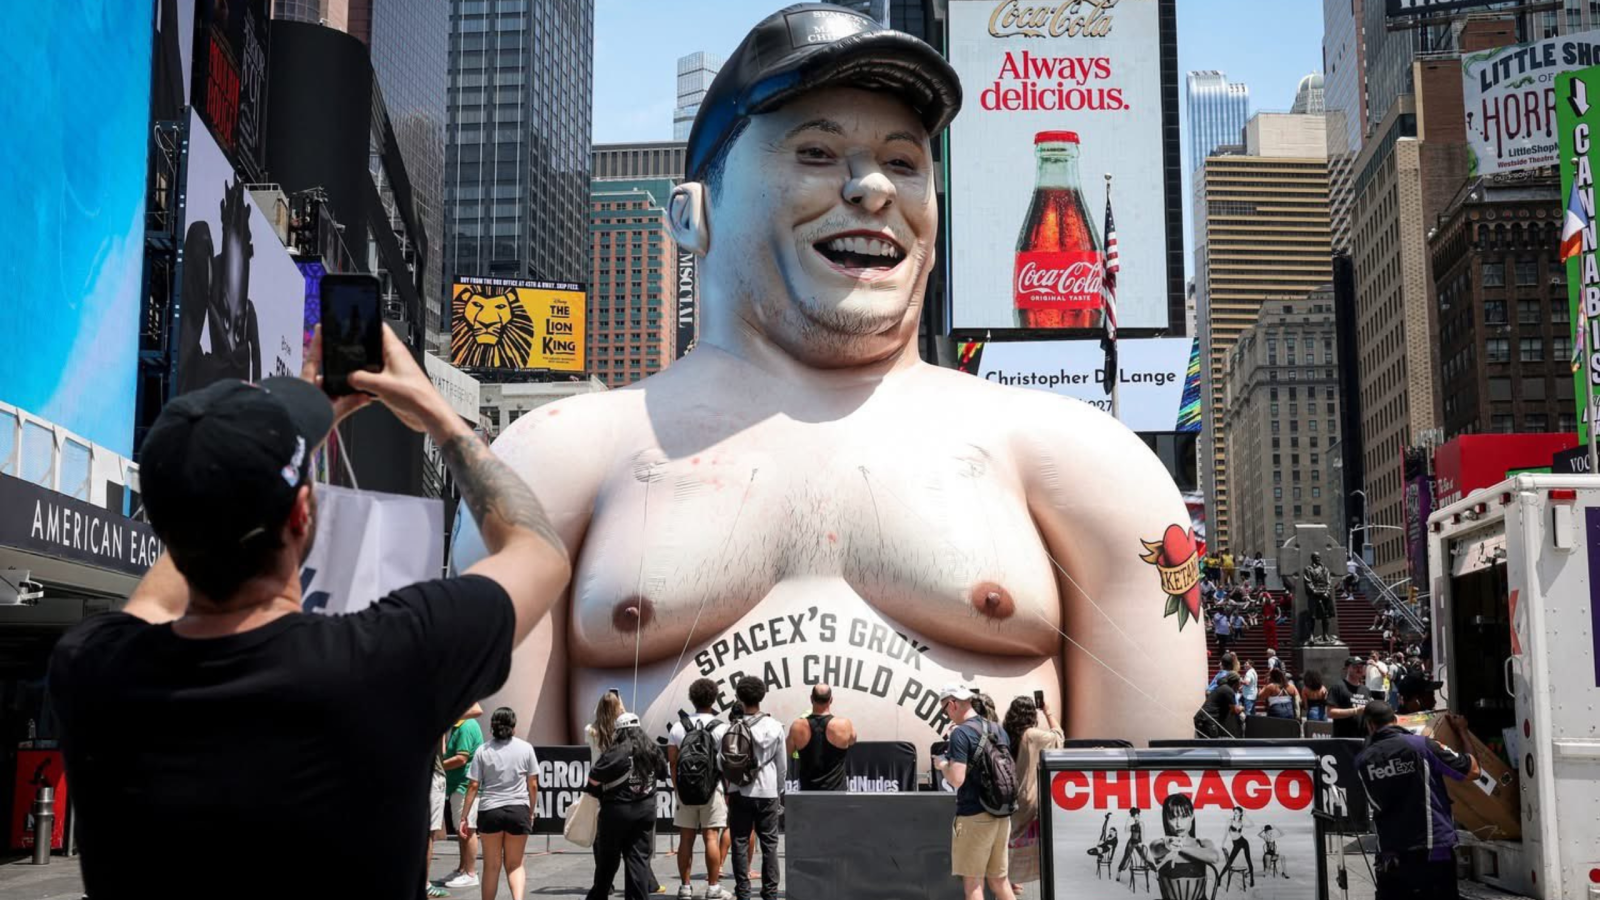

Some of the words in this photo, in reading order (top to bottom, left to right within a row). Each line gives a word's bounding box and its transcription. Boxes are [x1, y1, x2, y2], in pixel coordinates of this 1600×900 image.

[988, 0, 1118, 38] Coca-Cola
[998, 50, 1111, 86] Always
[1480, 43, 1557, 93] LITTLE
[1562, 41, 1600, 66] SHO
[1538, 73, 1554, 83] OF
[980, 81, 1130, 111] delicious.
[1482, 88, 1557, 150] HORR
[1497, 159, 1527, 168] Westside
[1529, 155, 1554, 164] Theatre
[1508, 142, 1560, 157] LittleShopN
[1574, 122, 1600, 386] CANNABIS
[1018, 262, 1103, 294] Coca-Cola
[549, 305, 570, 315] THE
[546, 318, 573, 335] LION
[542, 336, 576, 355] KING
[985, 369, 1089, 388] Christopher
[1119, 369, 1177, 386] Lange
[1570, 454, 1591, 472] VOC
[31, 499, 123, 560] AMERICAN
[130, 530, 162, 568] EAGL
[694, 606, 837, 676] SPACEX'S
[849, 617, 931, 671] GROK
[763, 656, 791, 693] AI
[803, 655, 894, 699] CHILD
[897, 676, 950, 738] POR
[1367, 758, 1416, 781] FedEx
[534, 791, 553, 818] AI
[1051, 769, 1315, 811] CHICAGO
